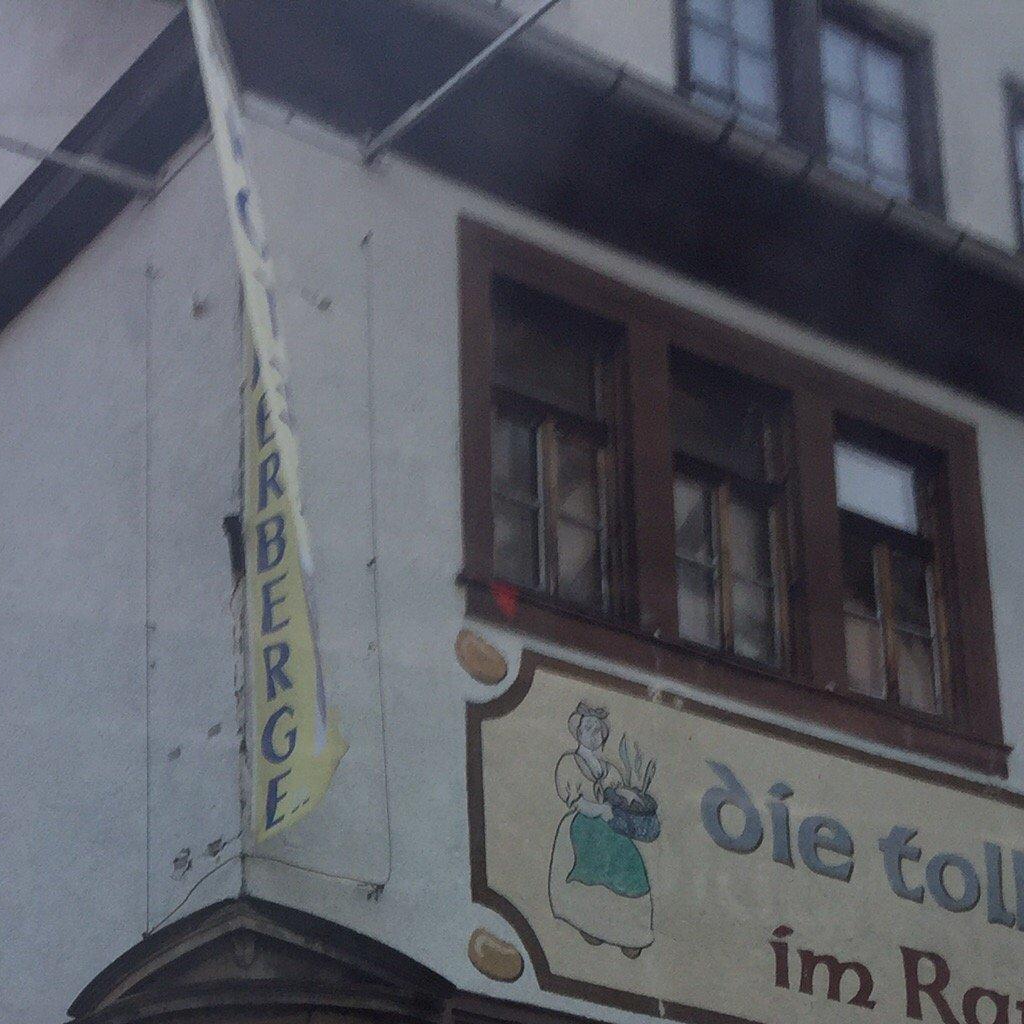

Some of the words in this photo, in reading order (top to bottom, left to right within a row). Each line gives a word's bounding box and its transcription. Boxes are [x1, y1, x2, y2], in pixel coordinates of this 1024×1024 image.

[252, 349, 298, 830] ERBERGE
[700, 759, 855, 883] die
[770, 925, 876, 1009] im
